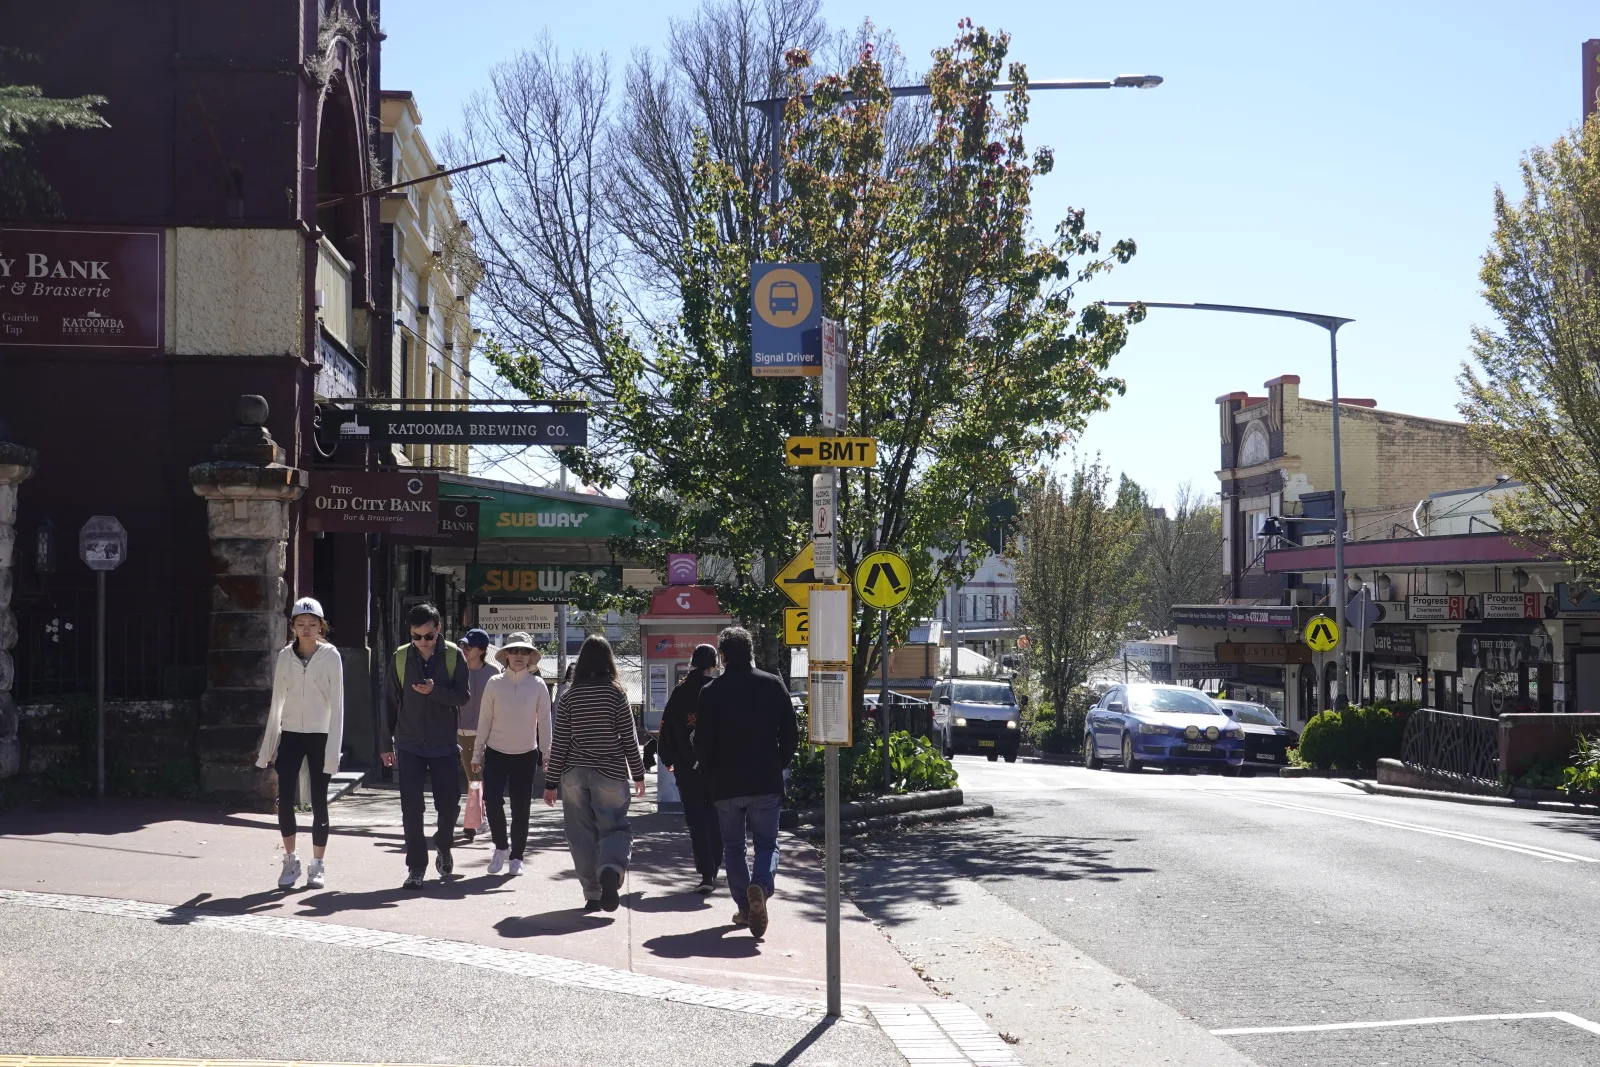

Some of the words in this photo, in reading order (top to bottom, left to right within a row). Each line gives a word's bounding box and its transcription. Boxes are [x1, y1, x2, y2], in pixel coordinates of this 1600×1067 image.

[11, 281, 26, 295] &
[32, 282, 111, 297] Brasserie
[2, 312, 39, 322] Garden
[62, 318, 124, 328] KATOOMBA
[3, 324, 23, 336] Tap
[755, 352, 784, 364] Signal
[786, 353, 815, 362] Driver
[388, 423, 464, 436] KATOOMBA
[469, 424, 538, 436] BREWING
[547, 425, 569, 437] CO.
[818, 441, 870, 462] BMT
[331, 485, 353, 495] THE
[315, 496, 347, 510] OLD
[351, 496, 388, 511] CITY
[343, 513, 358, 521] Bar
[367, 514, 404, 522] Brasserie
[496, 511, 589, 528] SUBWAY
[1413, 596, 1449, 606] Progress
[1487, 594, 1524, 603] Progress
[510, 614, 524, 622] bags
[527, 622, 551, 630] TIME!
